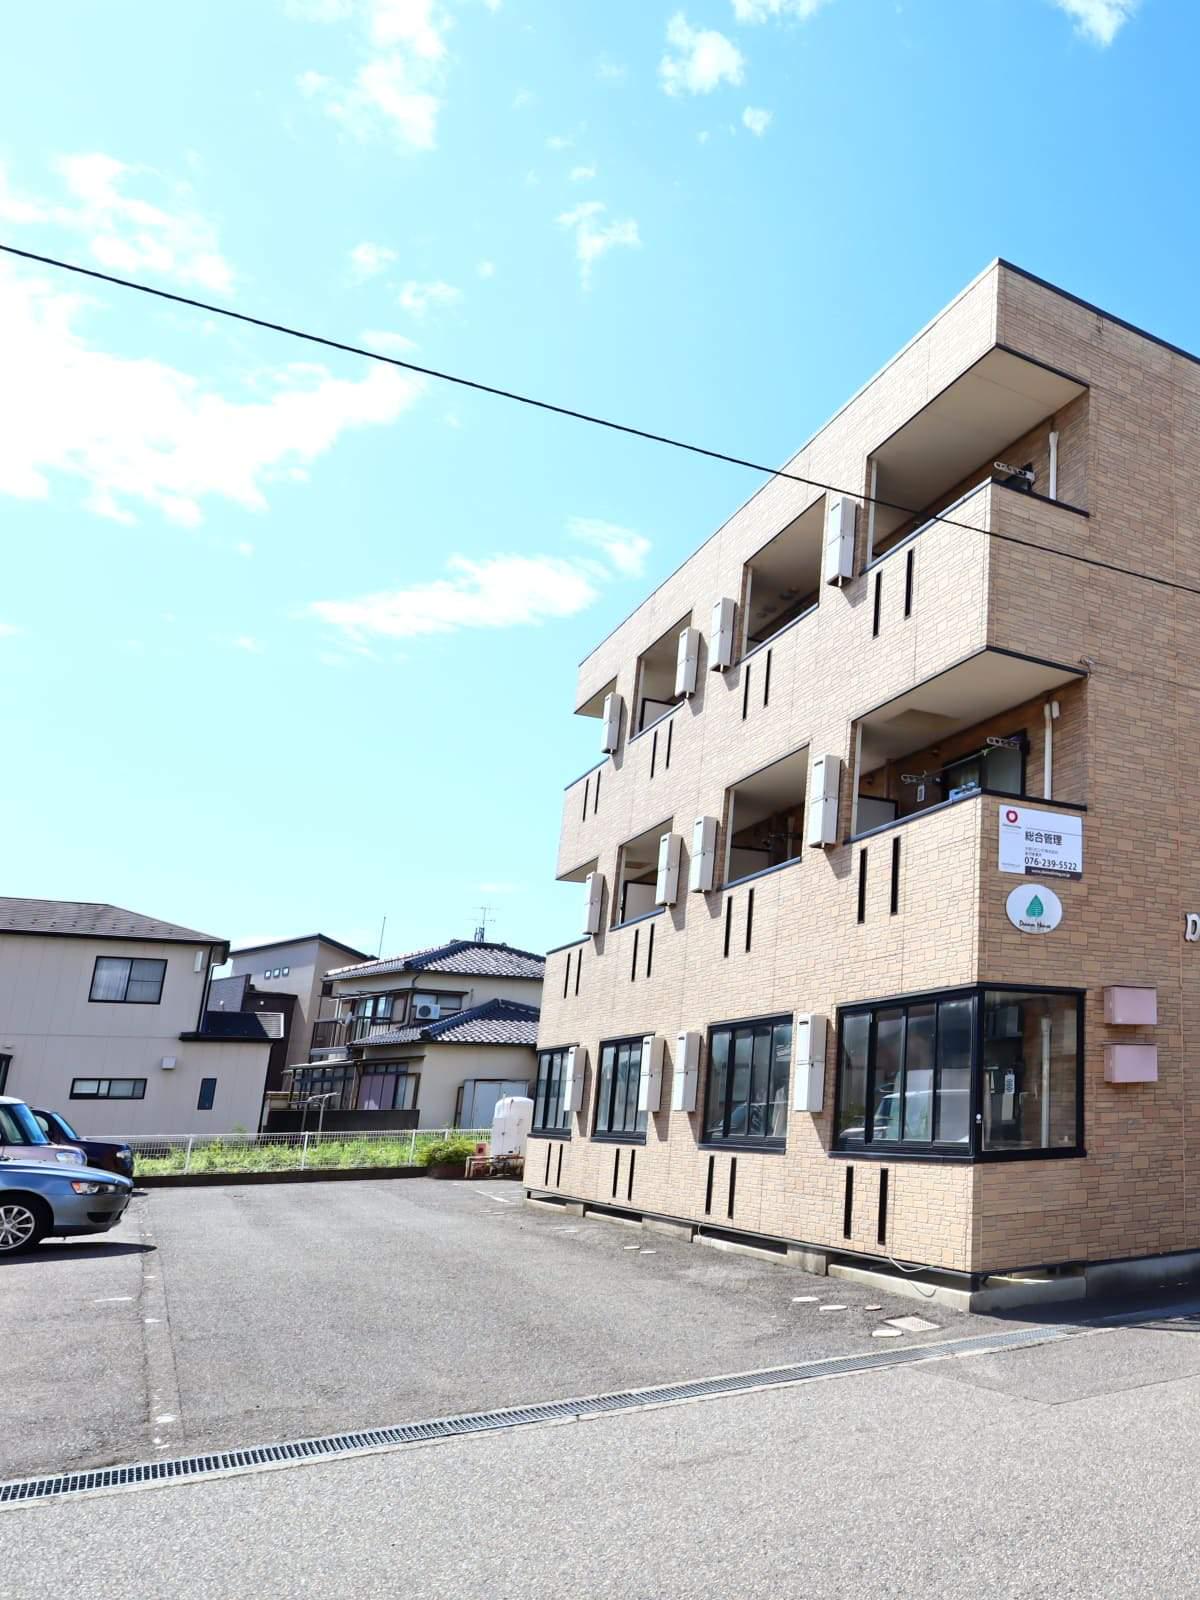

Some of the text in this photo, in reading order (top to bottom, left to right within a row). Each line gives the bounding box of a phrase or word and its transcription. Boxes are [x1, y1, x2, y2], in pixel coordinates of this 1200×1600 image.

[1025, 831, 1063, 846] 総合管理
[1024, 857, 1078, 871] 076-239-5522
